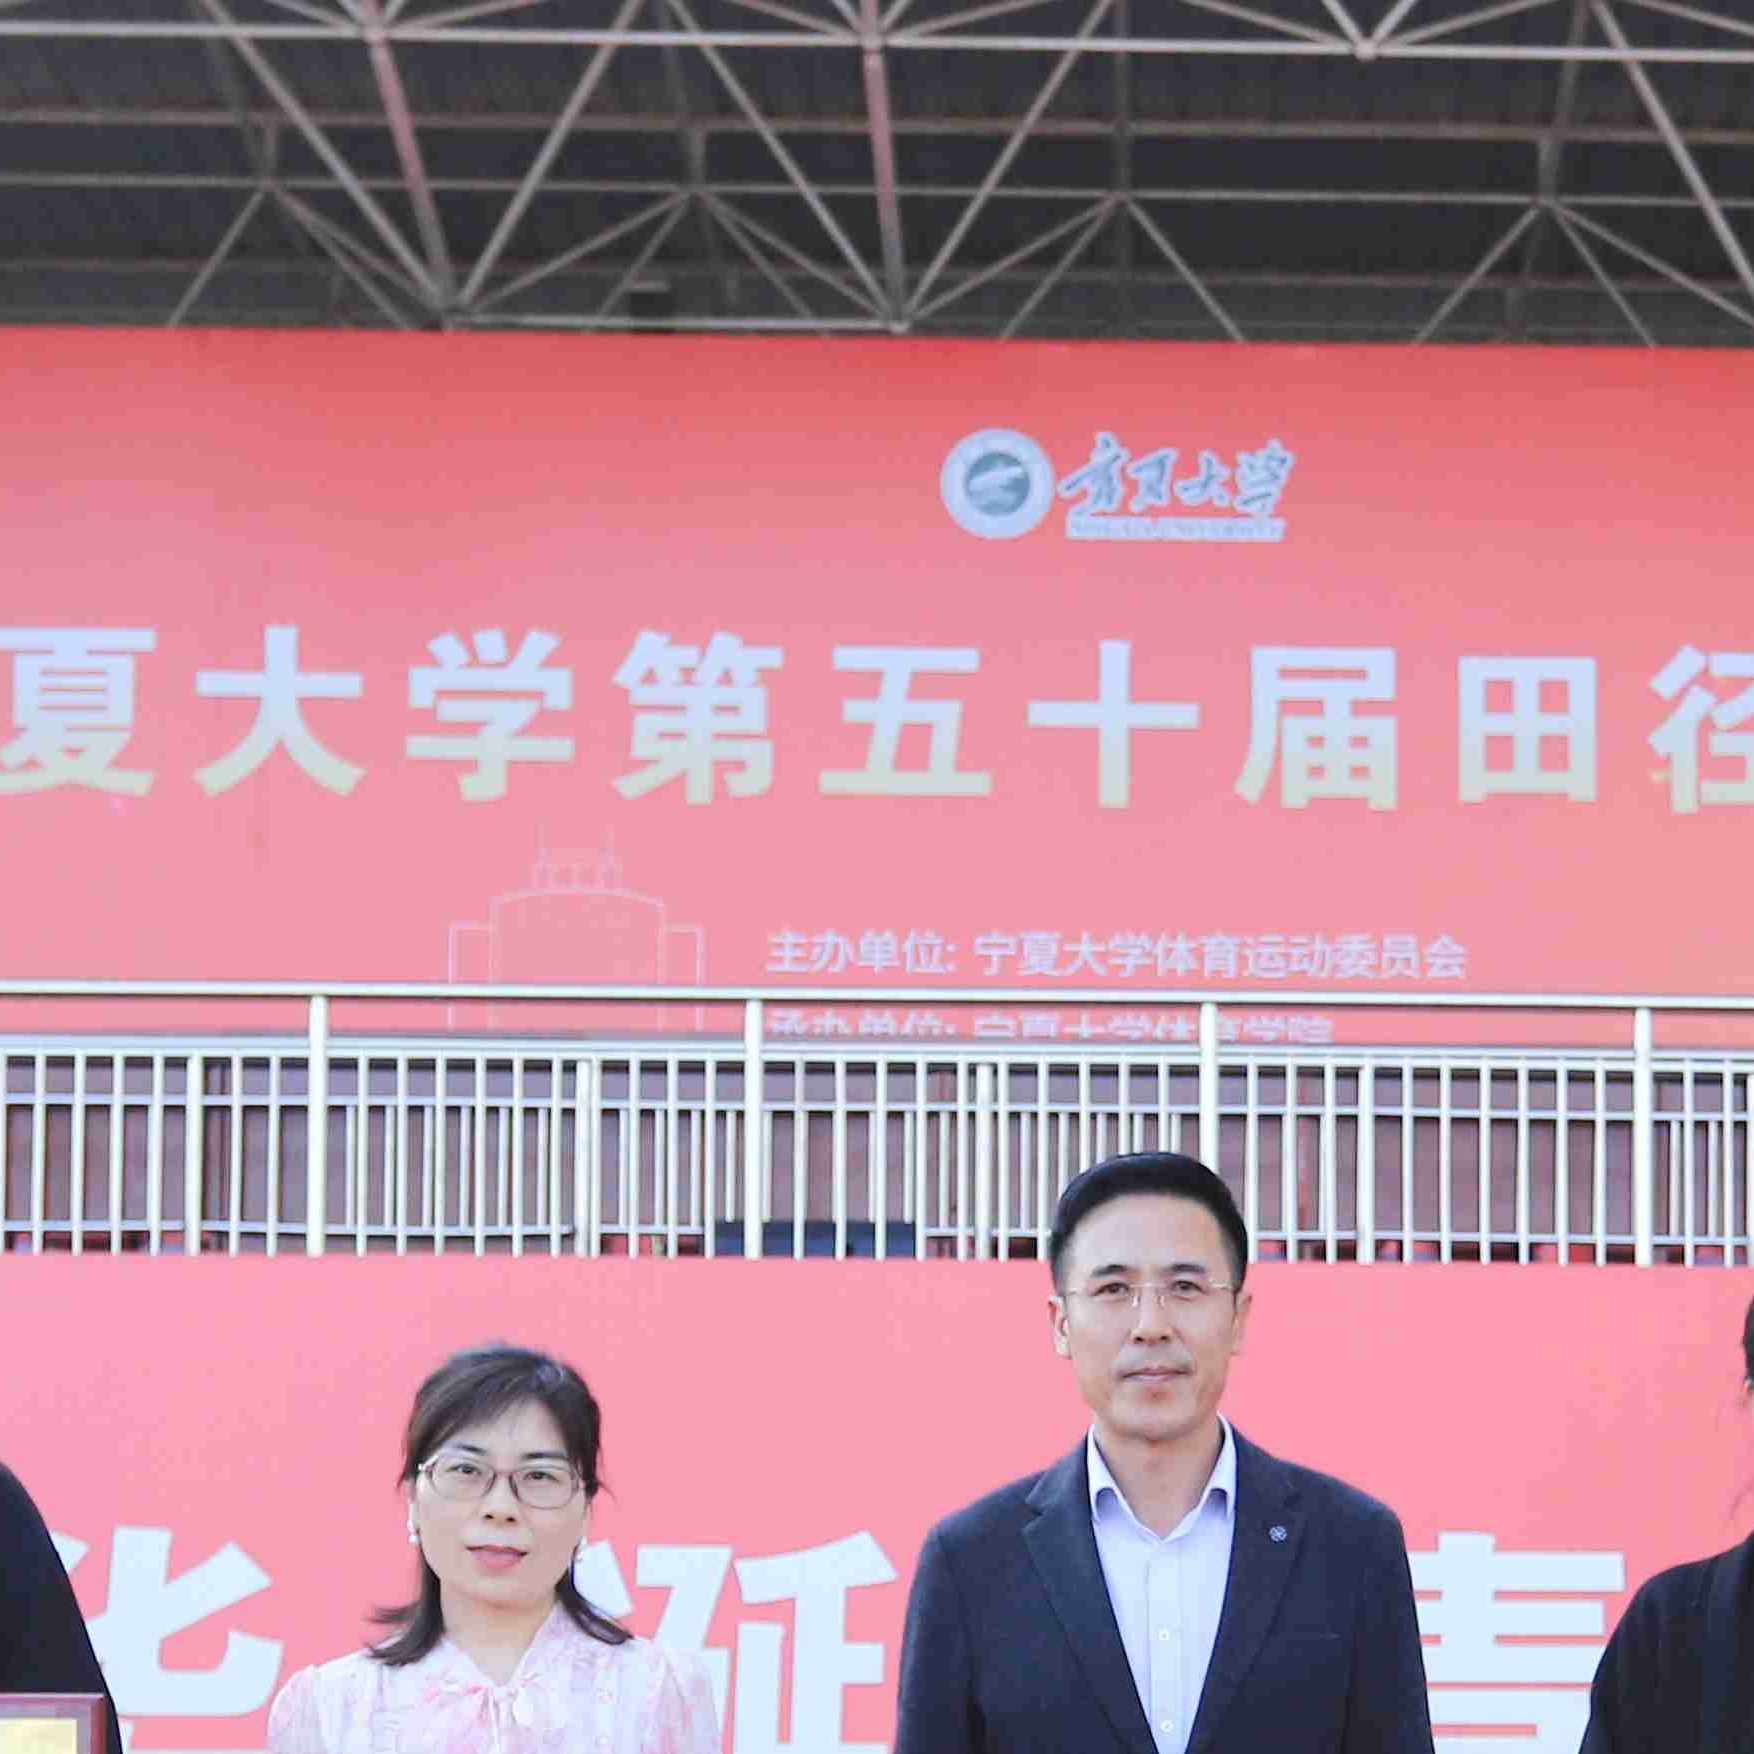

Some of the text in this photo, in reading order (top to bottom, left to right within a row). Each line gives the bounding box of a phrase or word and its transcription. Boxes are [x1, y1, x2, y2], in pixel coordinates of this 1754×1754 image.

[973, 931, 1468, 980] 宁夏大学体育运动委员会
